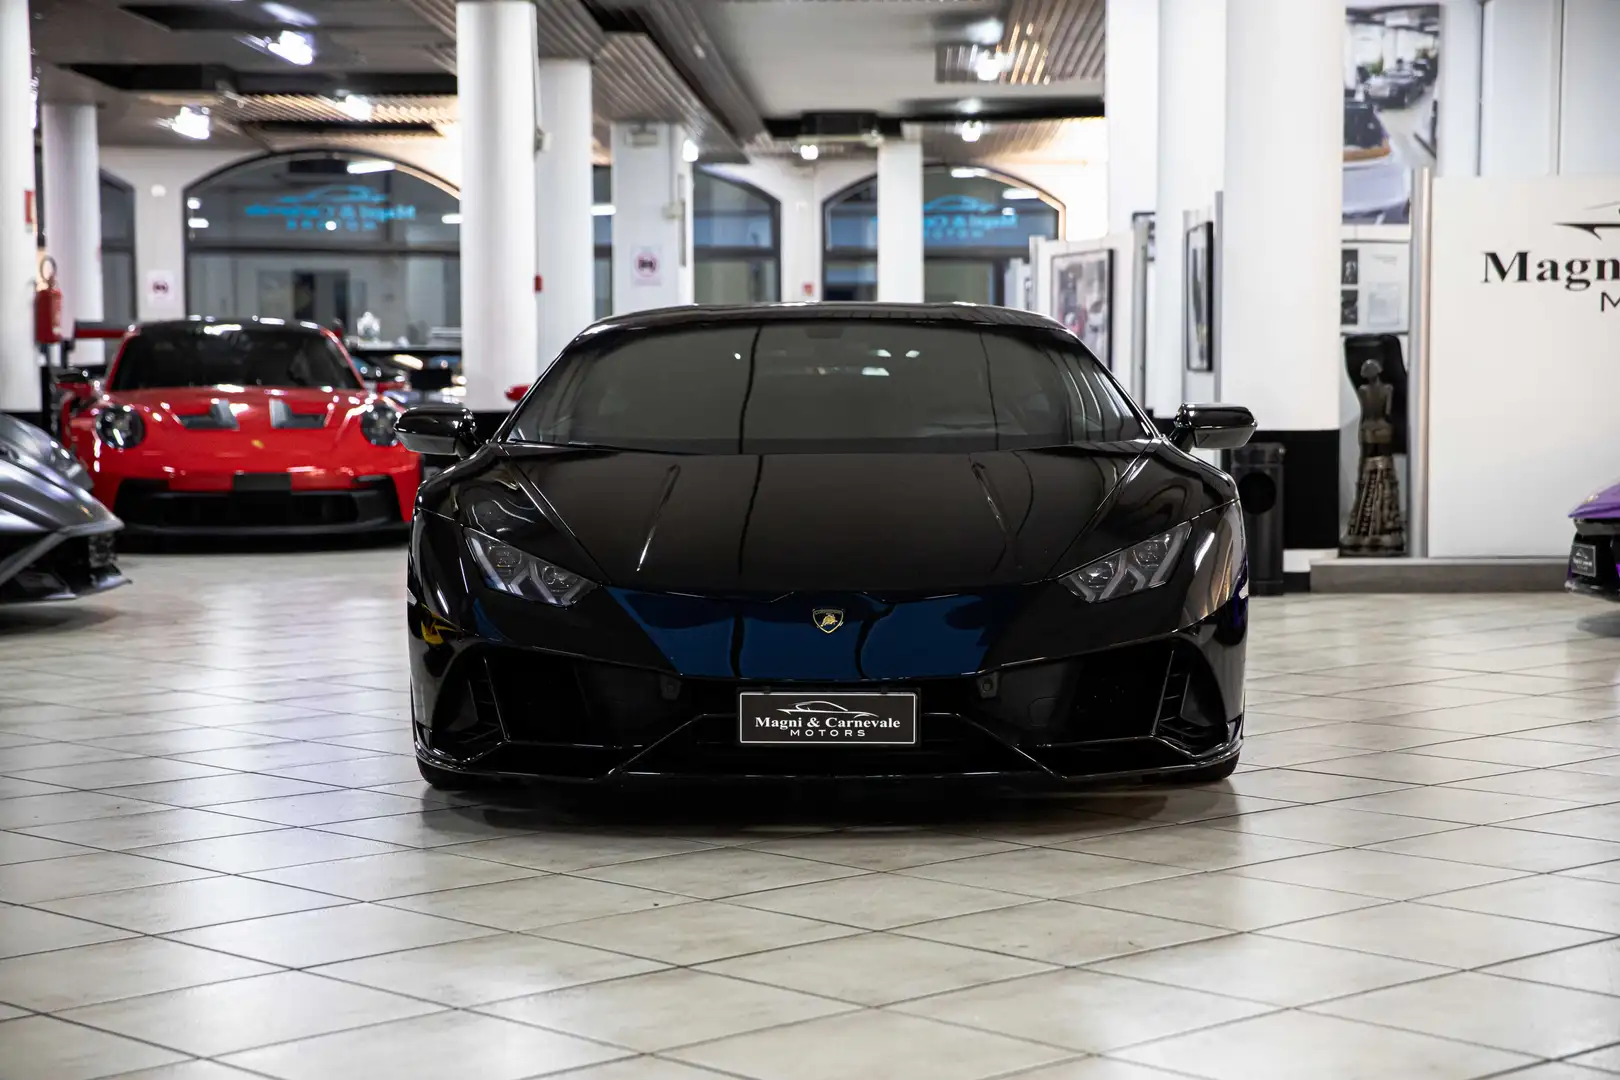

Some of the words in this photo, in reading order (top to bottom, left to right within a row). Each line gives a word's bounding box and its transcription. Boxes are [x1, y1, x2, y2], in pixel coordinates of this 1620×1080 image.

[755, 717, 802, 730] Magni
[807, 717, 820, 728] &
[825, 717, 901, 728] Carnevale
[790, 729, 866, 737] MOTORS
